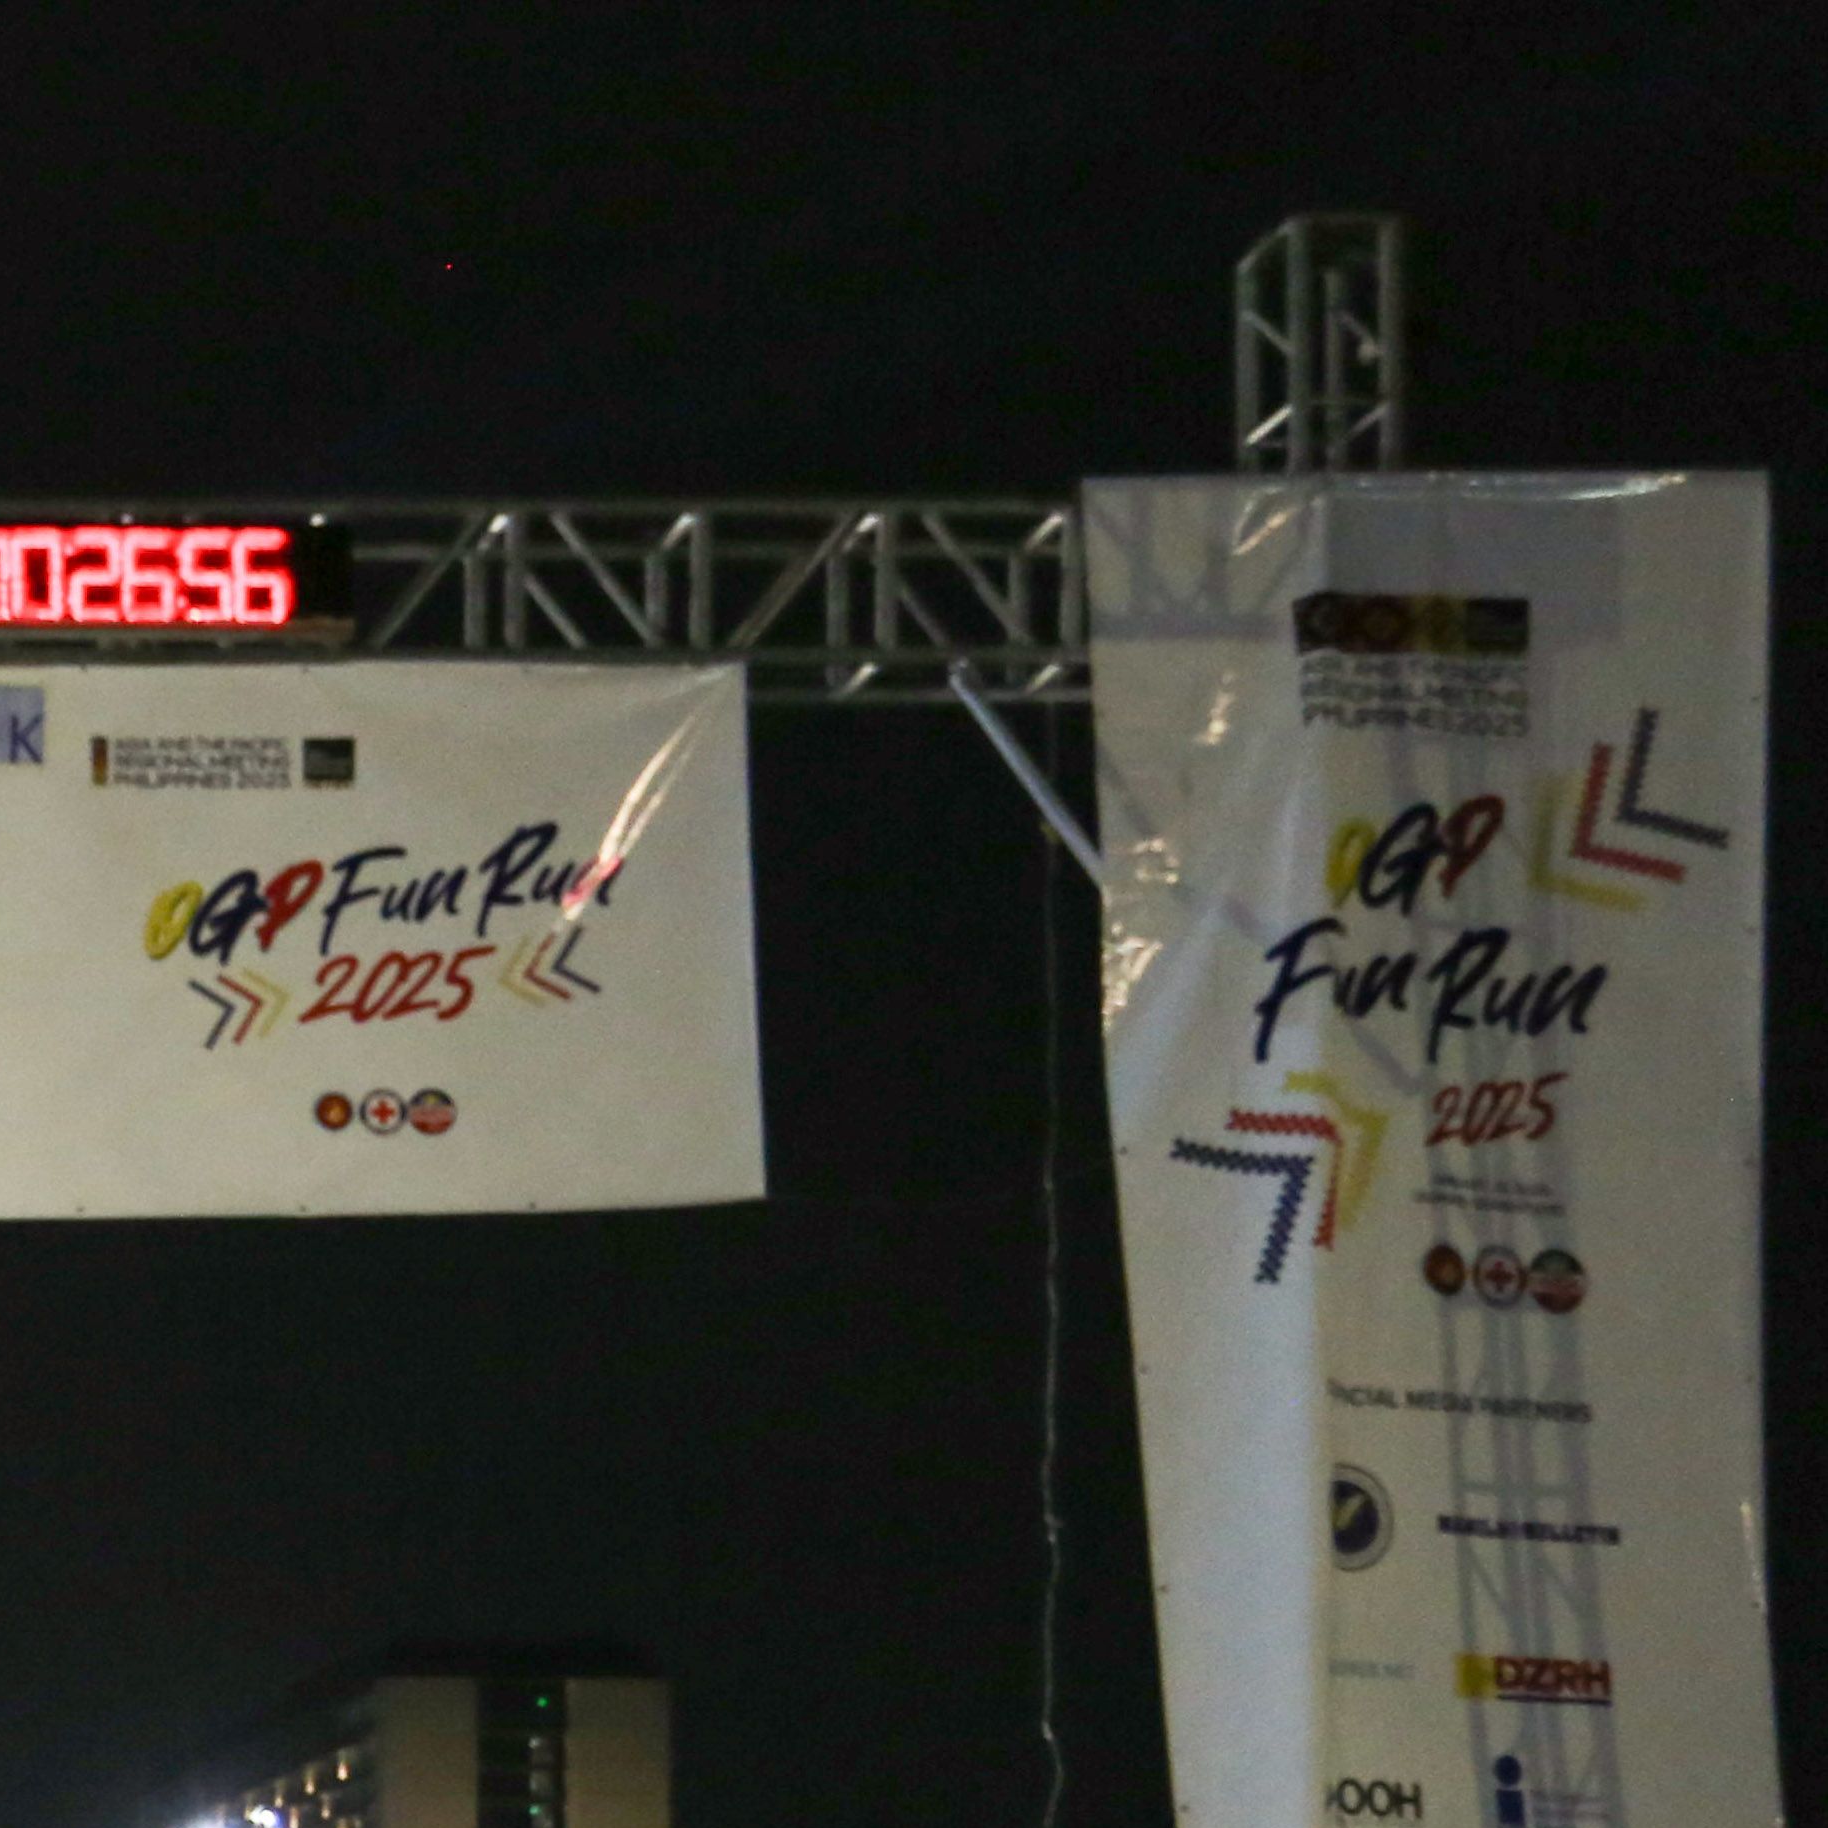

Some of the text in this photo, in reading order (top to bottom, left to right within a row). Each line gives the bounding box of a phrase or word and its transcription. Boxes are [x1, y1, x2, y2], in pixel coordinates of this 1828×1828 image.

[146, 823, 623, 966] OGP Fun Run
[299, 944, 496, 1026] 2025
[1427, 927, 1609, 1064] Run
[1425, 1073, 1570, 1147] 2025
[1494, 1655, 1611, 1696] DZRH
